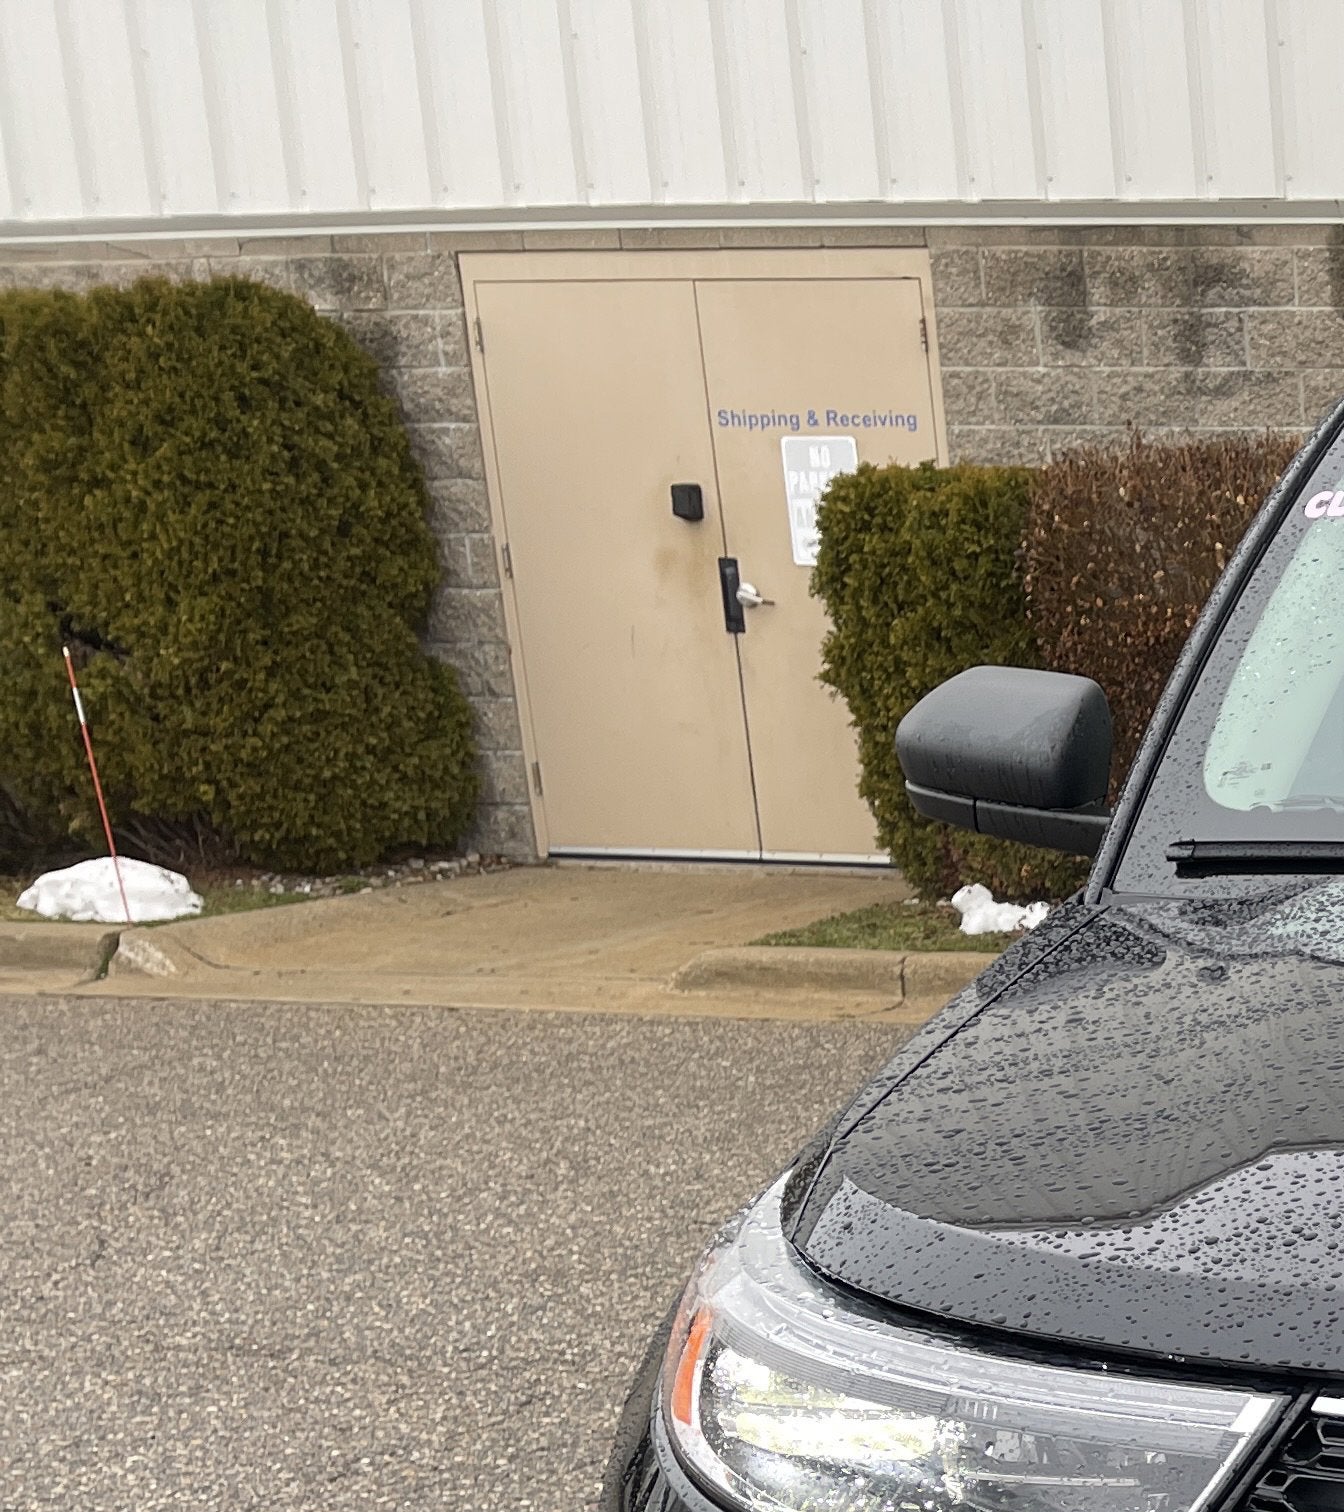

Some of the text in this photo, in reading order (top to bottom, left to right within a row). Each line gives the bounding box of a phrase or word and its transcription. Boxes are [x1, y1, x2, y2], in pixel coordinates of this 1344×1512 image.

[717, 409, 918, 431] Shipping & Receiving
[809, 445, 831, 468] NO
